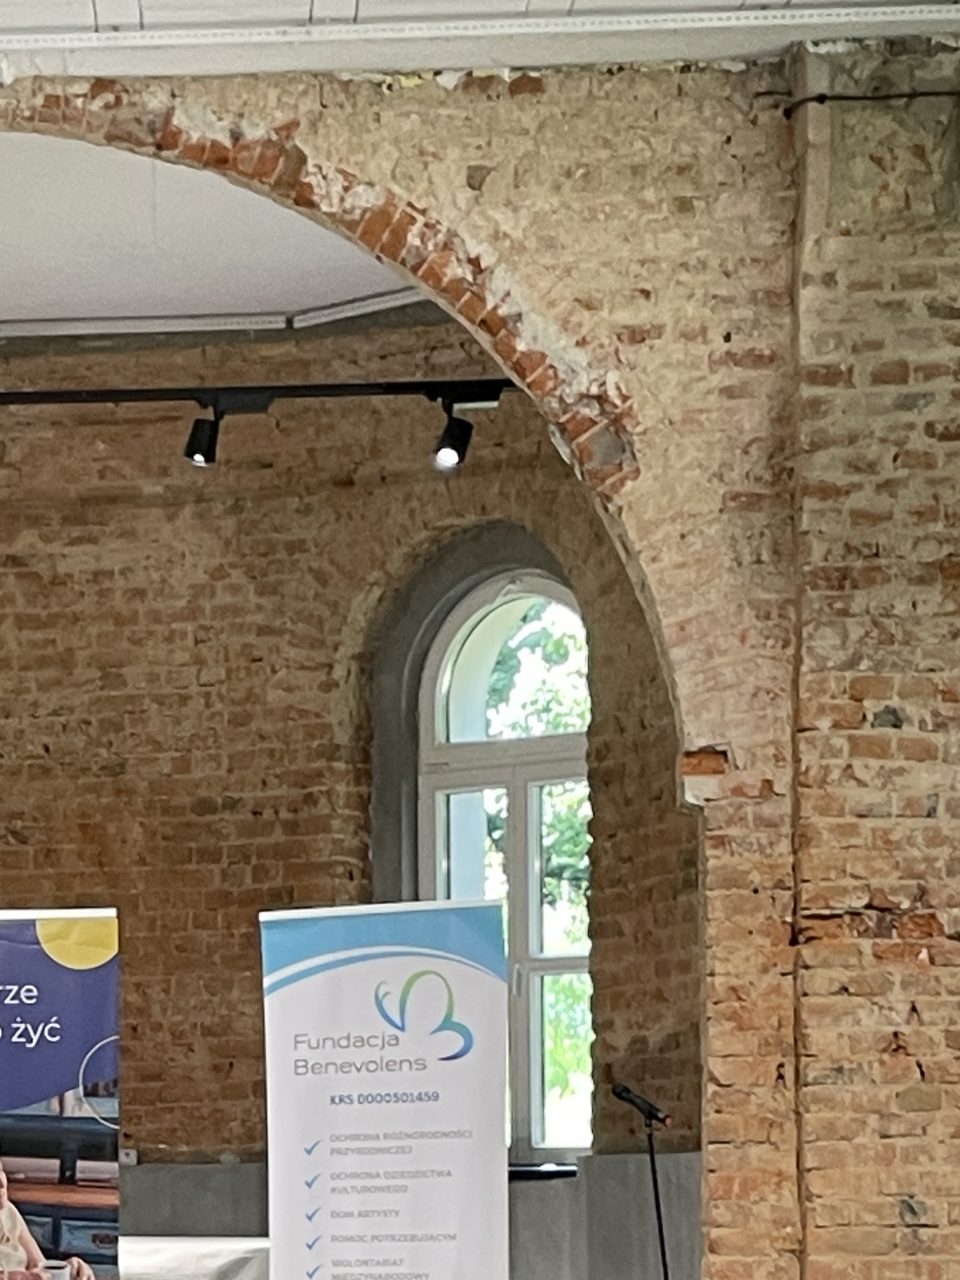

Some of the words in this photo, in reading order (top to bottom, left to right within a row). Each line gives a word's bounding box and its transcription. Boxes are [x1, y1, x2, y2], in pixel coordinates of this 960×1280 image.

[10, 1016, 62, 1049] żyć
[293, 1031, 400, 1051] Fundacja
[293, 1056, 428, 1077] Benevolens
[329, 1094, 355, 1106] KRS
